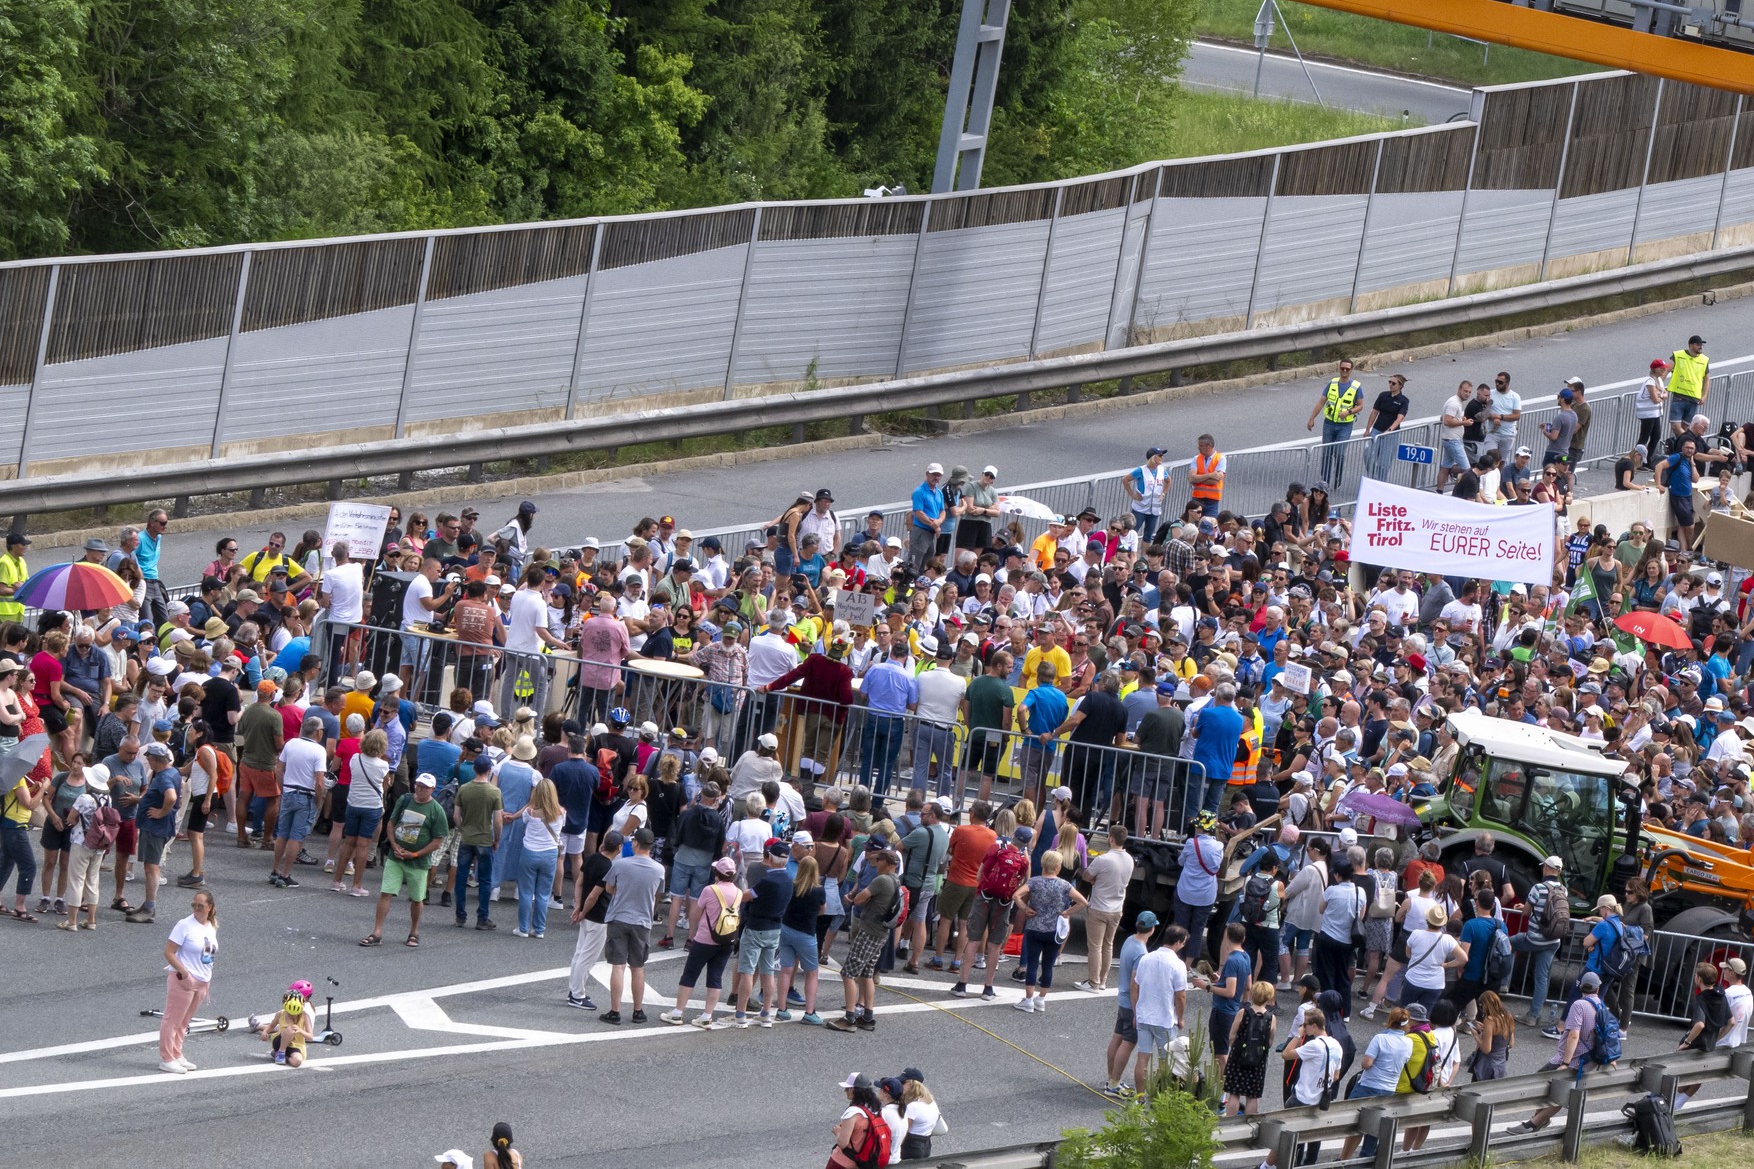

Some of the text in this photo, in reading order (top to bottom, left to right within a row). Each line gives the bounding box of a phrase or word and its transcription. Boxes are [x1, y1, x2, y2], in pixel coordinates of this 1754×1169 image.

[1404, 446, 1427, 462] 19,0
[1367, 502, 1408, 518] Liste
[1376, 517, 1416, 532] Fritz.
[1421, 518, 1490, 537] Wir stehen auf
[1366, 532, 1404, 547] Tirol
[1429, 532, 1543, 561] EURER Seite!
[1686, 866, 1706, 878] CARGO
